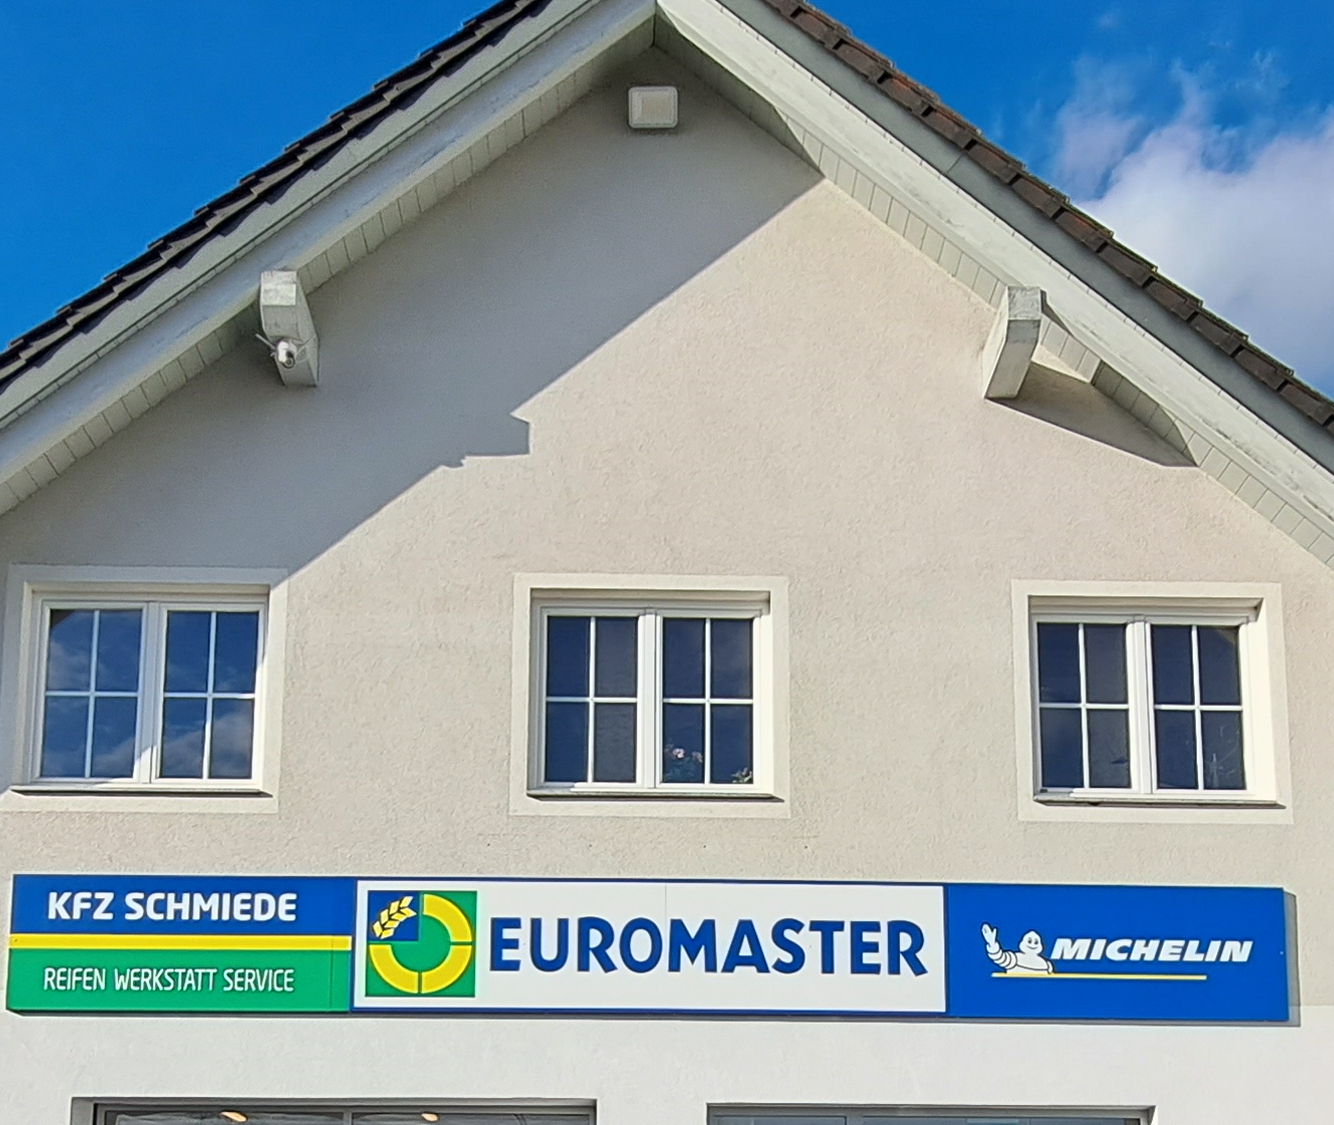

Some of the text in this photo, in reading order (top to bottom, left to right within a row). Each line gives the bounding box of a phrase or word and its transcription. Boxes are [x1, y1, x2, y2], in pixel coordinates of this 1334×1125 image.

[48, 892, 297, 921] KFZ SCHMIEDE
[489, 916, 929, 977] EUROMASTER
[1050, 938, 1253, 962] MICHELIN
[44, 967, 294, 992] REIFEN WERKSTATT SERVICE
